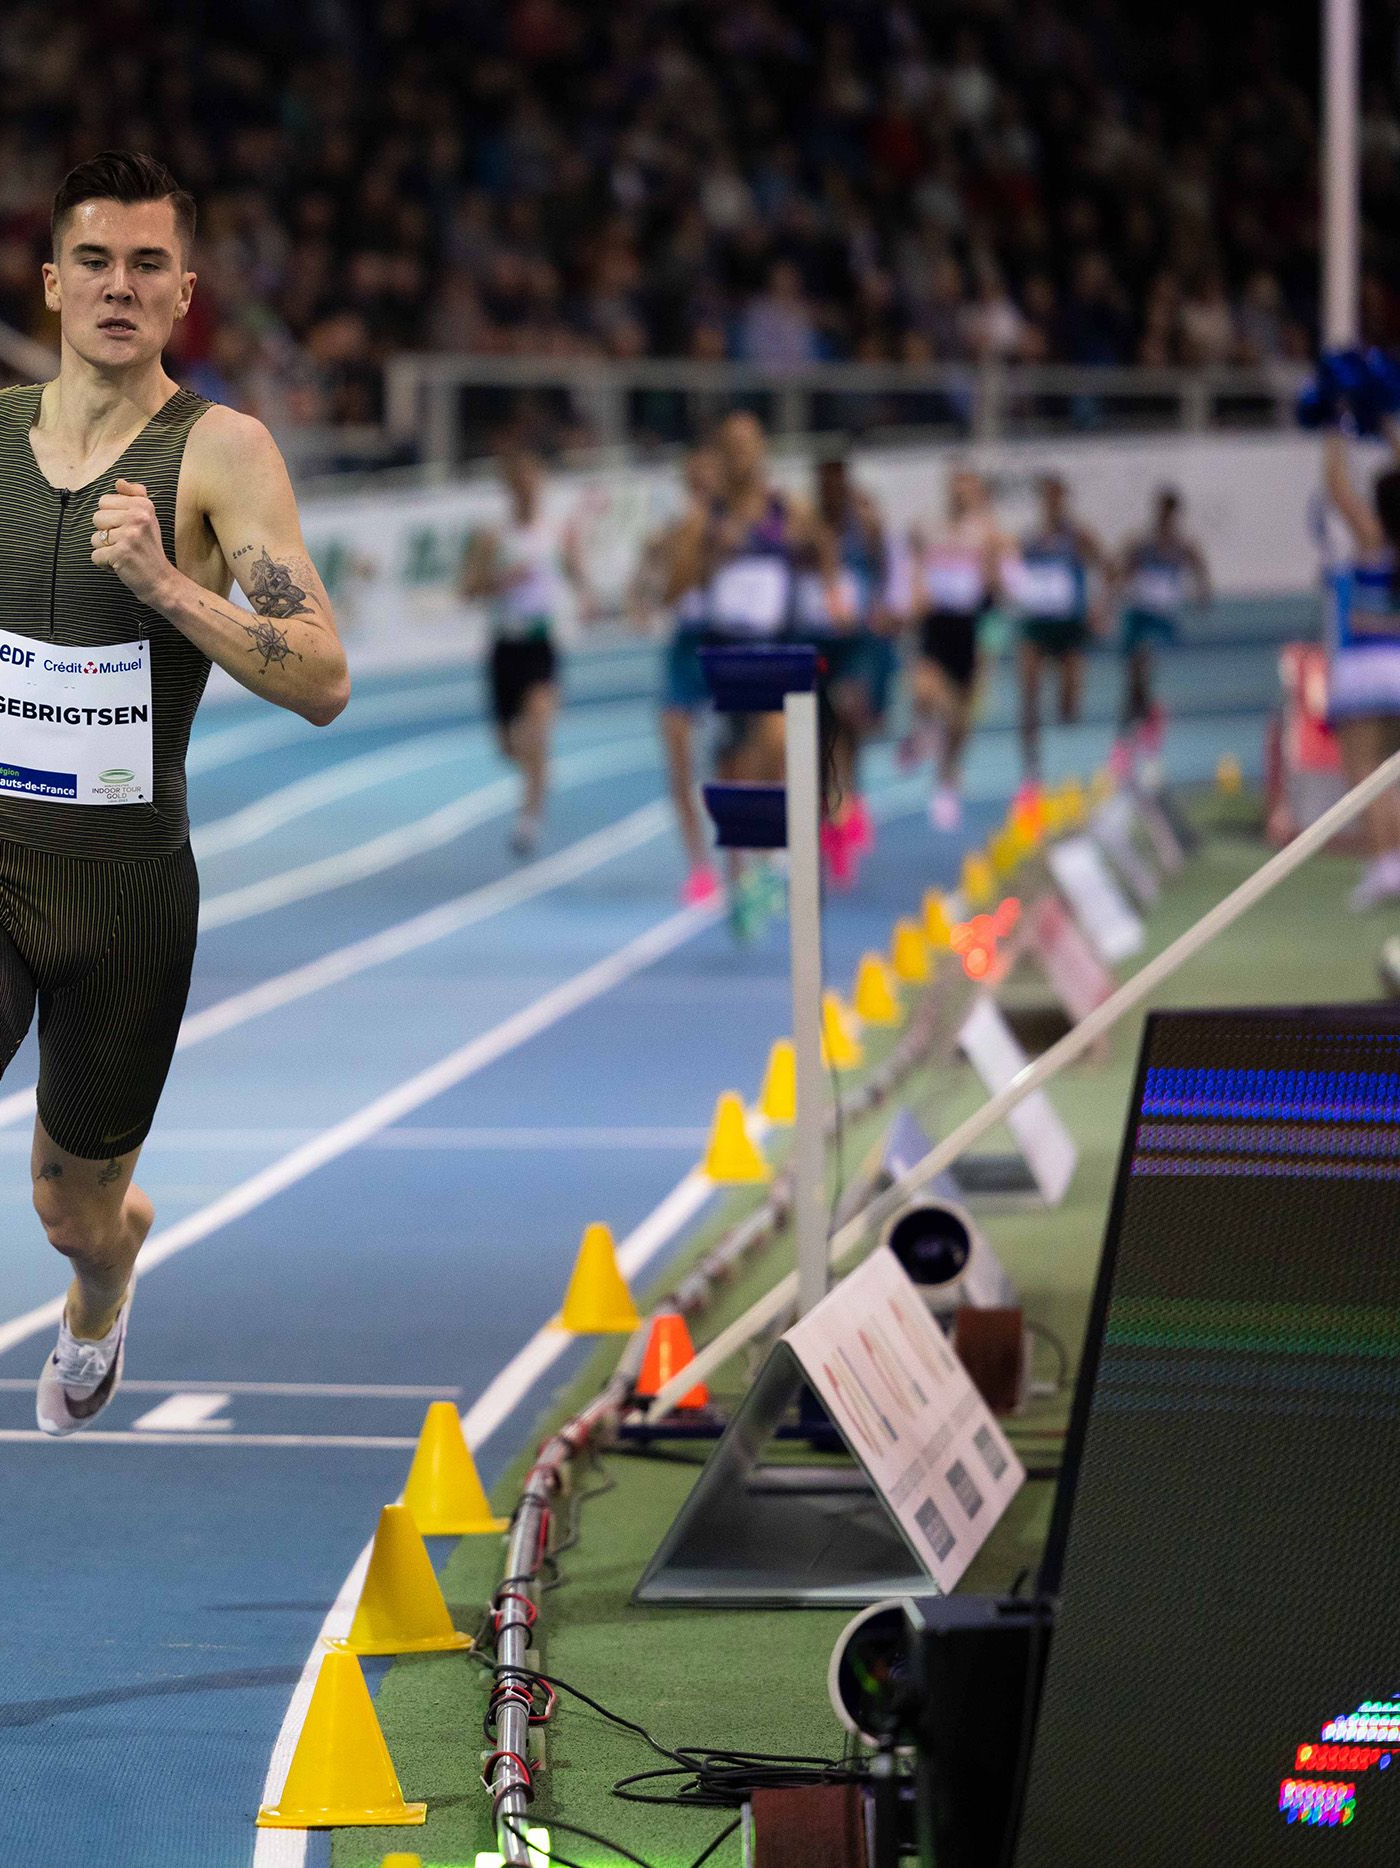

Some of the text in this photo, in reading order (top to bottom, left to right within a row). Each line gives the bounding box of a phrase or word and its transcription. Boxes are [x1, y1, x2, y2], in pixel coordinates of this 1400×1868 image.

[43, 657, 142, 674] Crédit Mutuel
[121, 785, 142, 793] TOUR
[106, 792, 128, 800] GOLD
